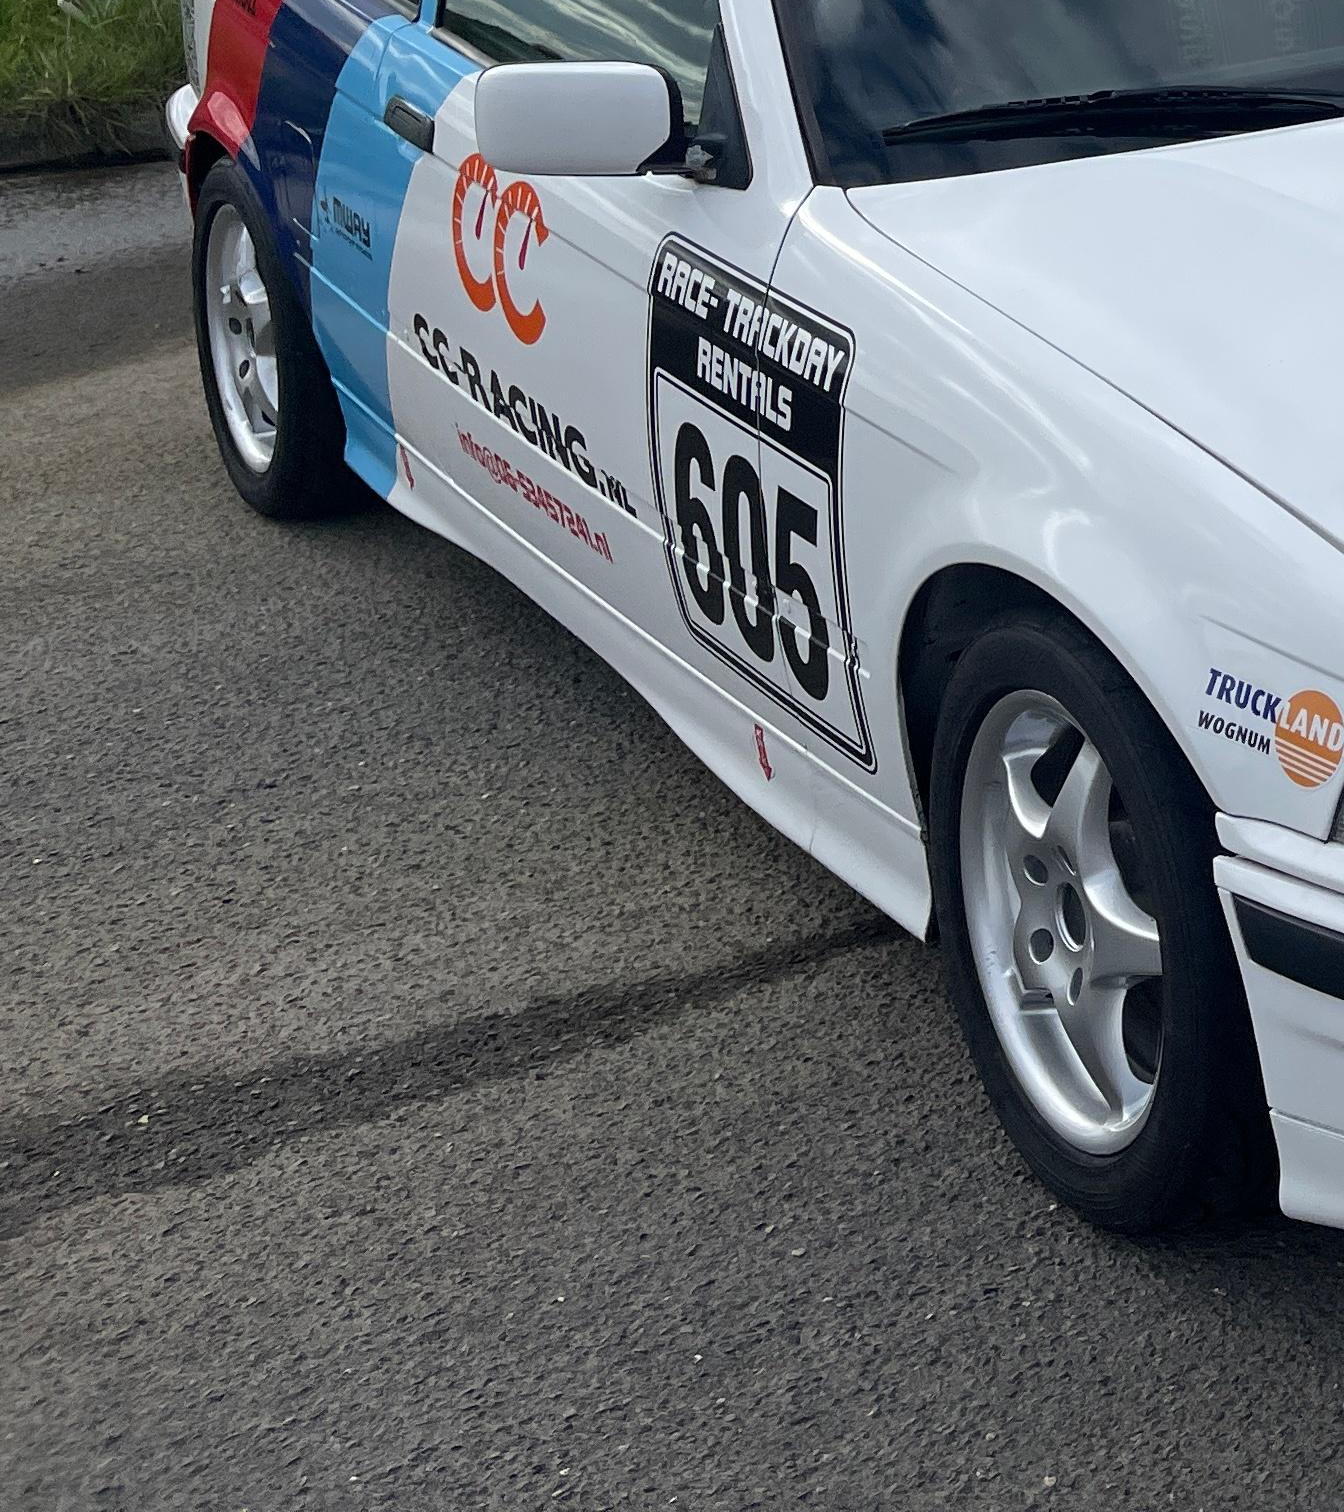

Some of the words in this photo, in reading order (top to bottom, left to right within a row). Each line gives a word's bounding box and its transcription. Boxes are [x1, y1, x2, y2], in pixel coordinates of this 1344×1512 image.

[453, 152, 550, 346] CC
[656, 252, 719, 321] RACE-
[724, 287, 845, 392] TRACKDAY
[412, 312, 637, 517] CC-RACING.NL
[695, 335, 794, 433] RENTALS
[672, 420, 831, 703] 605
[1197, 709, 1272, 756] WOGNUM
